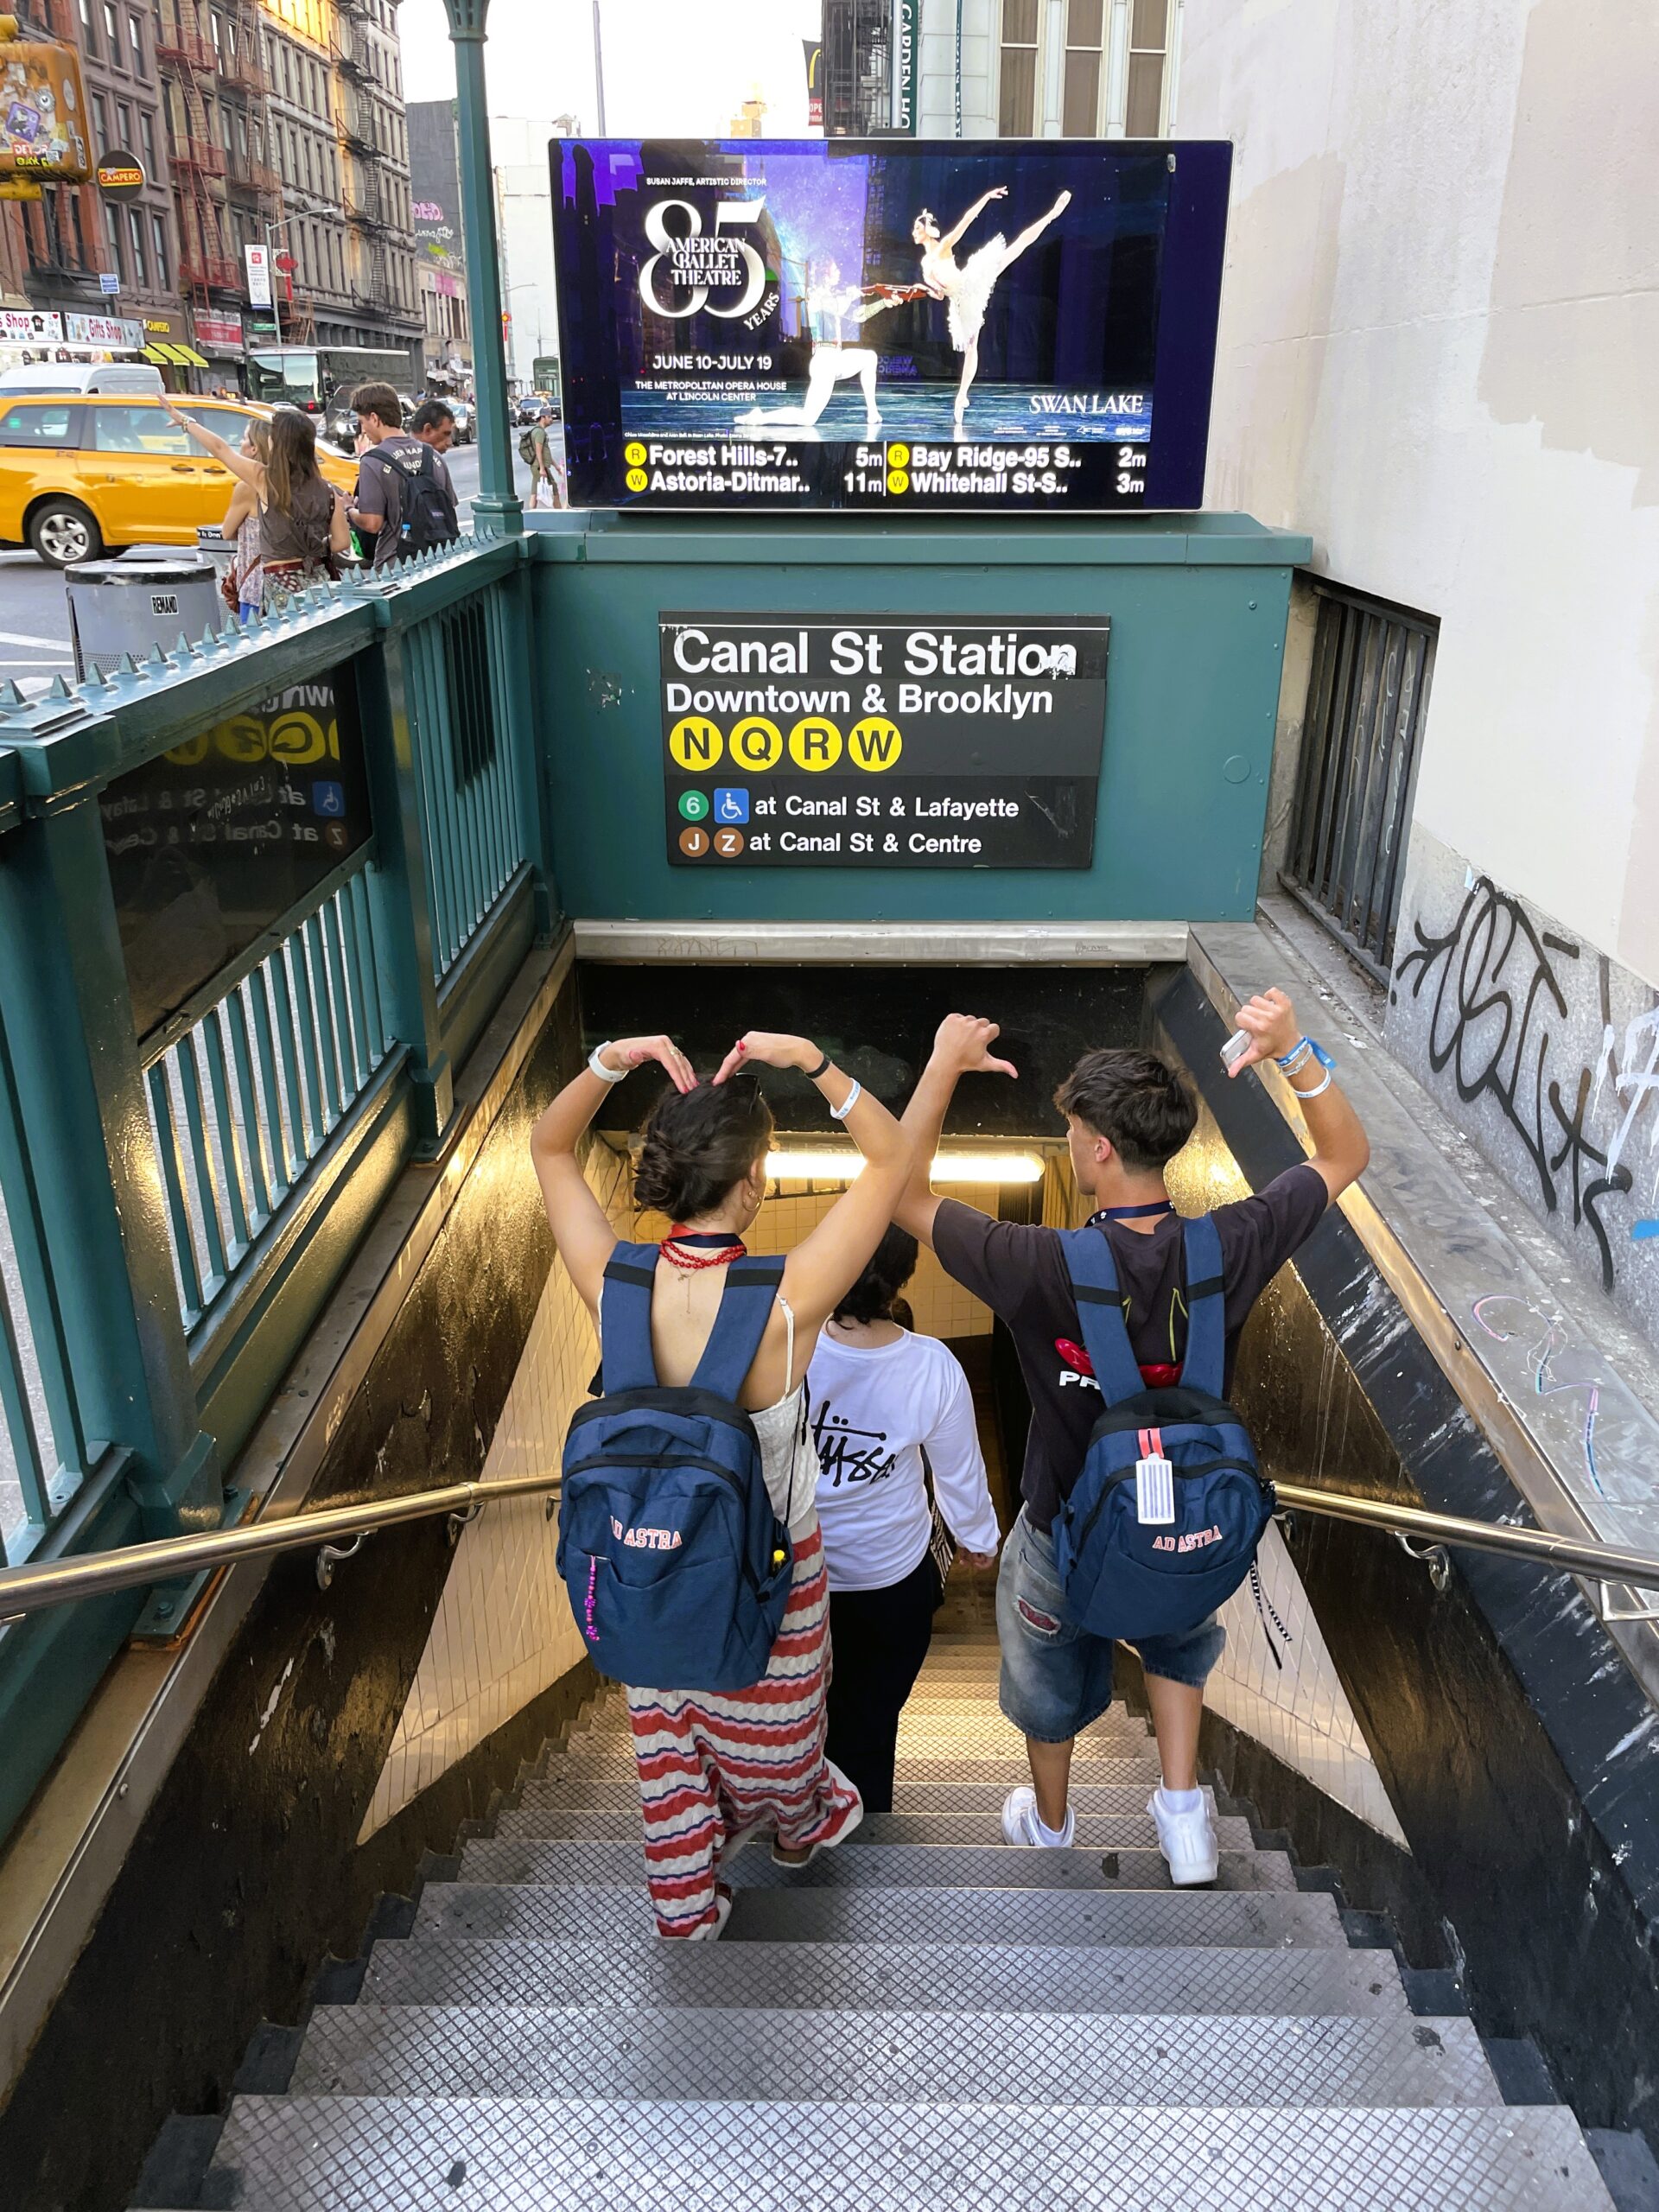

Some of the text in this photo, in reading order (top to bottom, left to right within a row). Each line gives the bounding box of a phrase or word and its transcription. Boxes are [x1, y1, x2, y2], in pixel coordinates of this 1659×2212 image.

[100, 173, 141, 181] CAMPERO
[646, 177, 671, 186] SUSAN
[671, 177, 696, 187] JAFFE,
[639, 194, 766, 318] 85
[666, 238, 747, 253] AMERICAN
[672, 251, 739, 270] BALLET
[671, 270, 742, 286] THEATRE
[5, 313, 29, 331] Shop
[743, 292, 780, 331] YEARS
[89, 318, 123, 341] Gifts Shop
[652, 355, 772, 370] JUNE 10-JULY 19
[635, 381, 787, 391] THE METROPOLITAN OPERA HOUSE
[666, 392, 756, 402] AT LINCOLN CENTER
[1029, 394, 1143, 415] SWAN LAKE
[649, 444, 717, 467] Forest
[855, 446, 883, 467] 5m
[912, 446, 952, 472] Bay
[957, 446, 1050, 472] Ridge-95
[1118, 447, 1147, 467] 2m
[843, 471, 883, 493] 11m
[911, 471, 1007, 493] Whitehall
[1116, 473, 1145, 493] 3m
[151, 596, 178, 614] REMAND
[672, 629, 1077, 678] Canal St Station
[666, 683, 1053, 720] Downtown & Brooklyn
[754, 797, 777, 816] at
[785, 796, 848, 817] Canal
[855, 797, 880, 817] St
[889, 797, 906, 817] &
[914, 797, 1020, 821] Lafayette
[749, 833, 772, 851] at
[779, 832, 842, 853] Canal
[849, 832, 874, 853] St
[882, 833, 899, 853] &
[908, 833, 982, 854] Centre
[623, 1528, 683, 1549] ASTRA
[1152, 1524, 1224, 1554] AD ASTRA
